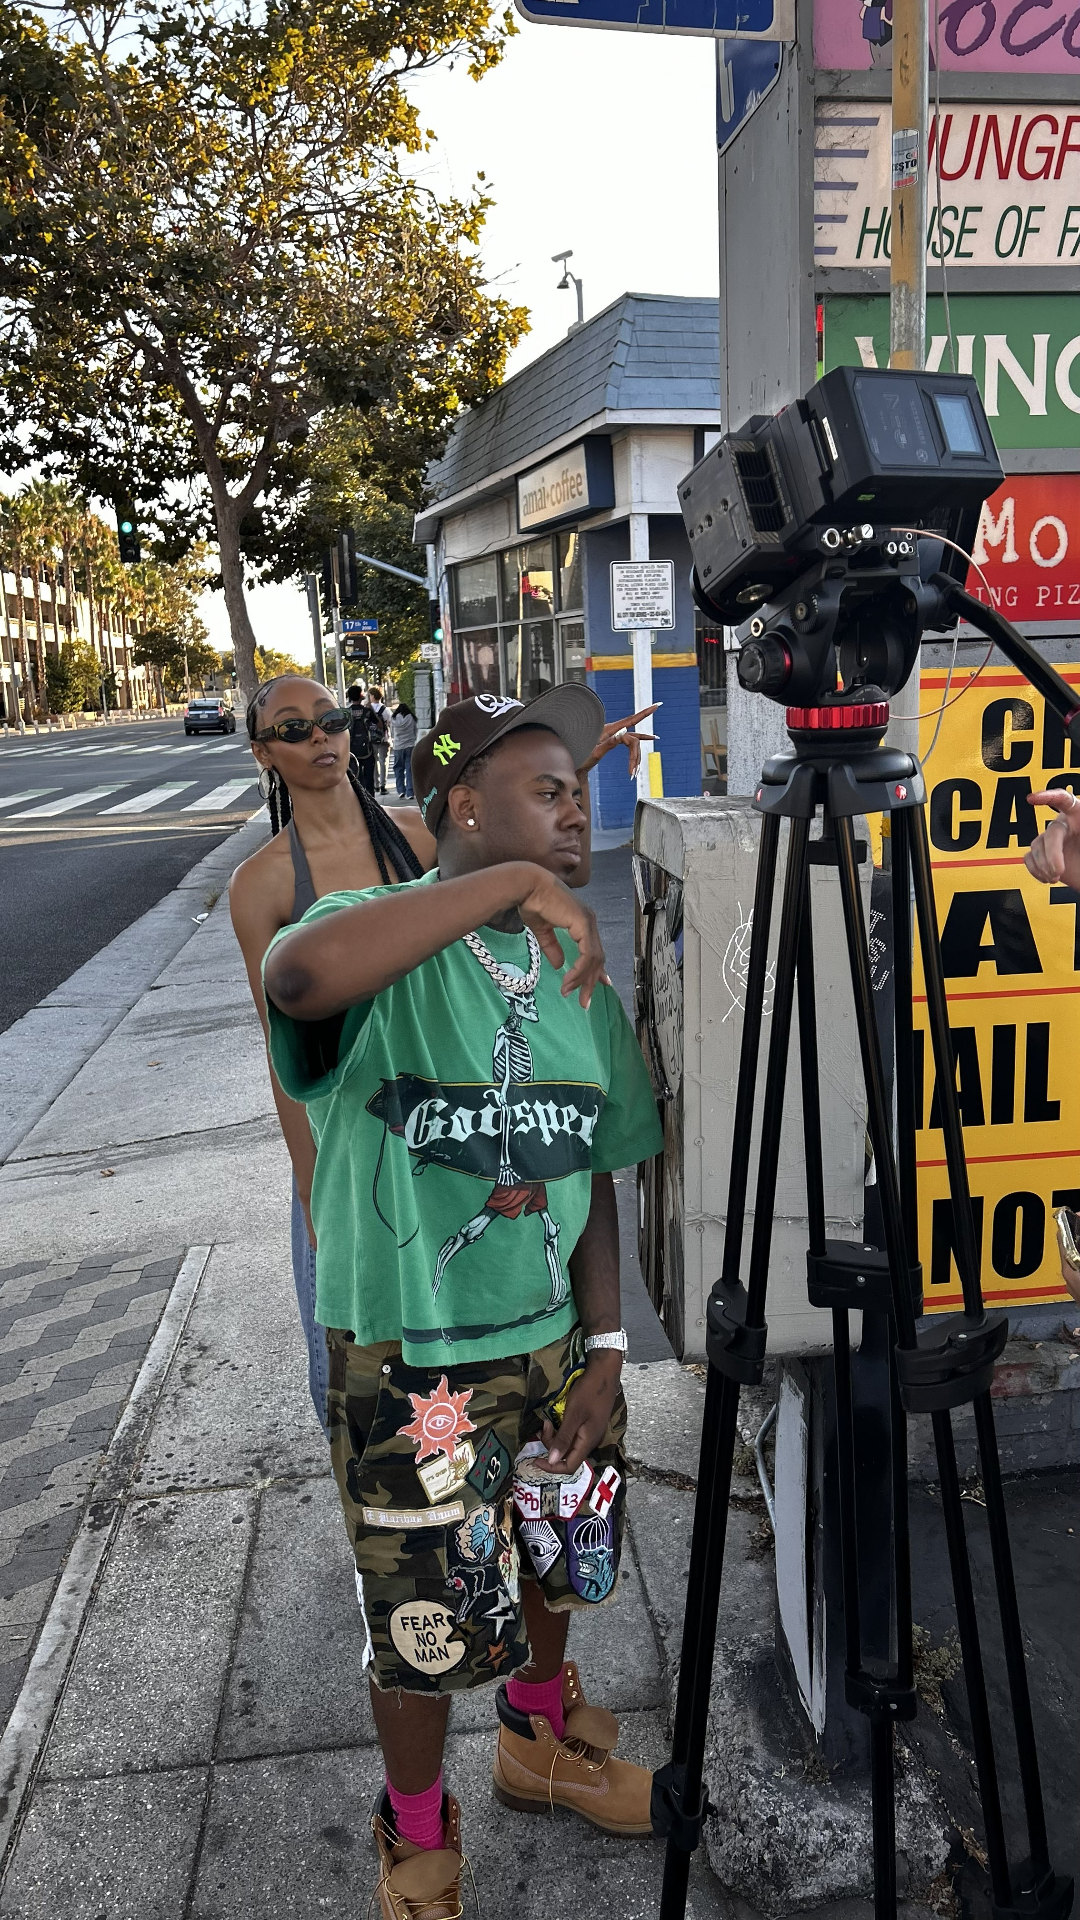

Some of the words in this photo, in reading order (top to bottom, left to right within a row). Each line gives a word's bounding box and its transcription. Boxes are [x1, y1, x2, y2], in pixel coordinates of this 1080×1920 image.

[995, 205, 1046, 258] OF
[1057, 206, 1080, 257] F
[966, 586, 1018, 607] ING
[913, 1022, 1061, 1130] AIL
[561, 1494, 579, 1508] 13
[400, 1612, 446, 1631] FEAR
[415, 1631, 436, 1647] NO
[414, 1645, 450, 1662] MAN
